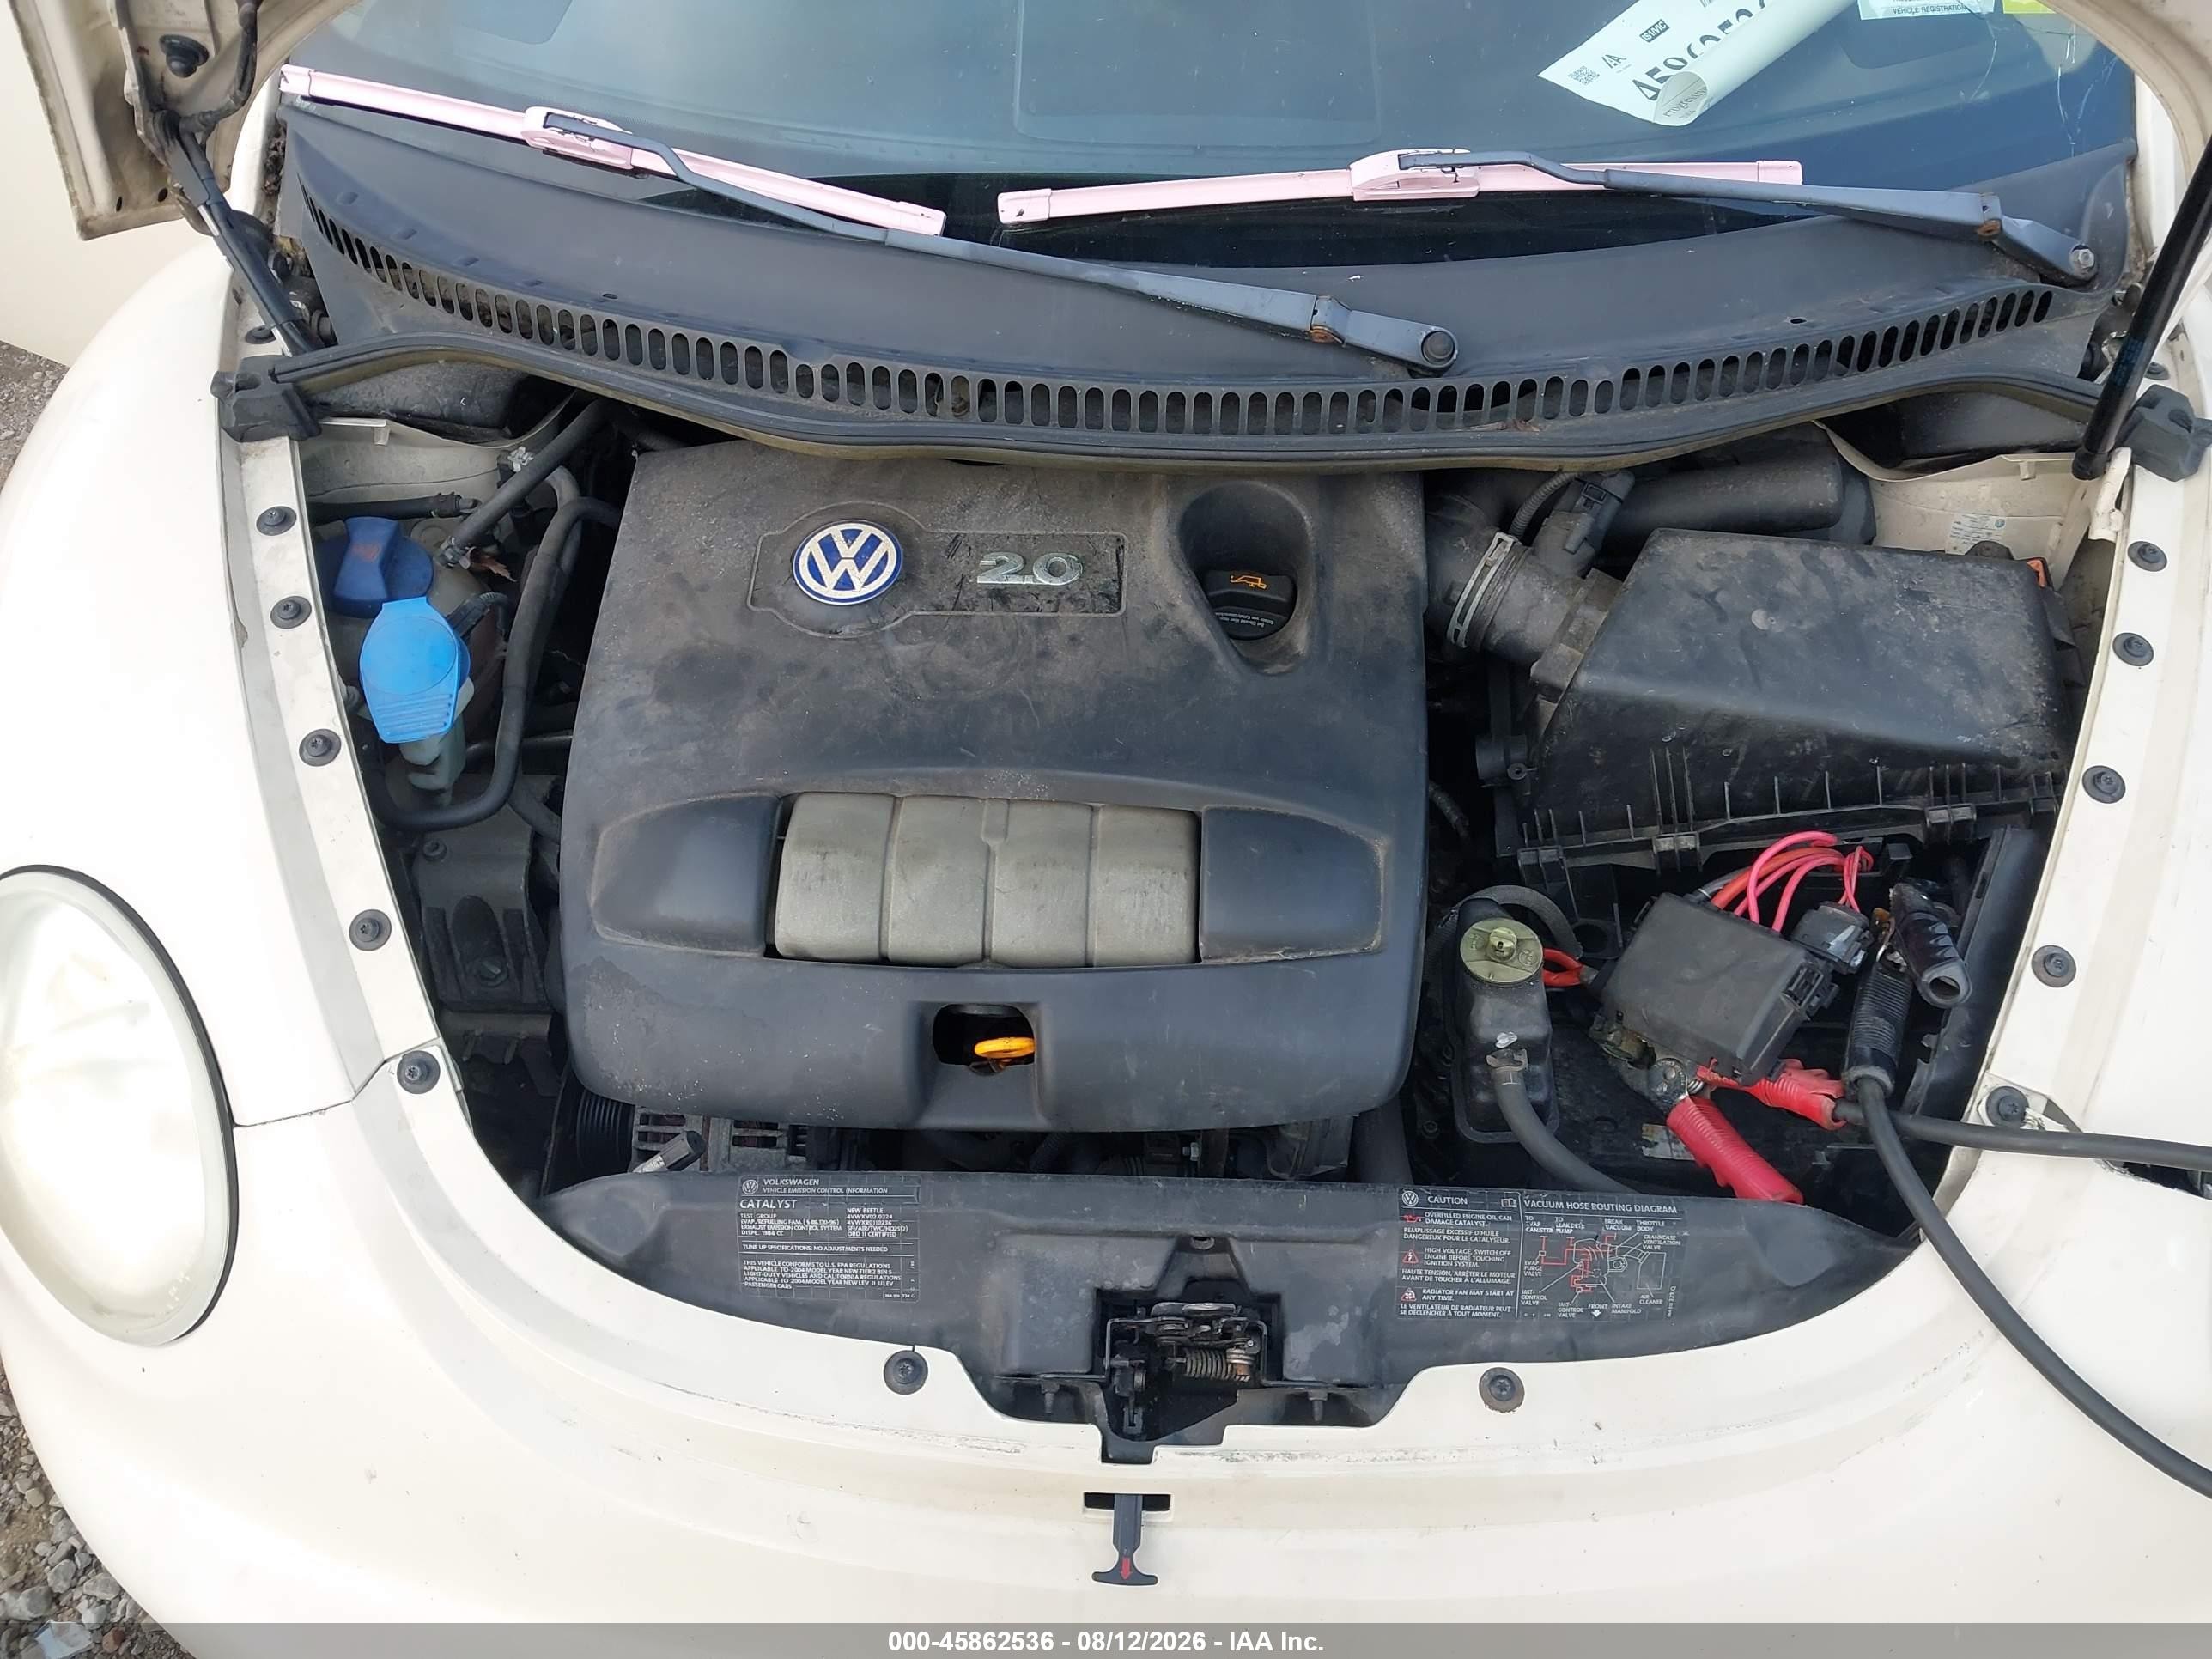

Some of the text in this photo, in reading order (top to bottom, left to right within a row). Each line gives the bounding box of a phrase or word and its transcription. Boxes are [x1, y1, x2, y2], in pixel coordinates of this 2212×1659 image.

[1892, 6, 1918, 15] VEHICLE
[739, 1199, 797, 1209] CATALYST
[1427, 1195, 1468, 1205] CAUTION
[1523, 1200, 1678, 1213] VACUUM HOSE ROUTING DIAGRAM
